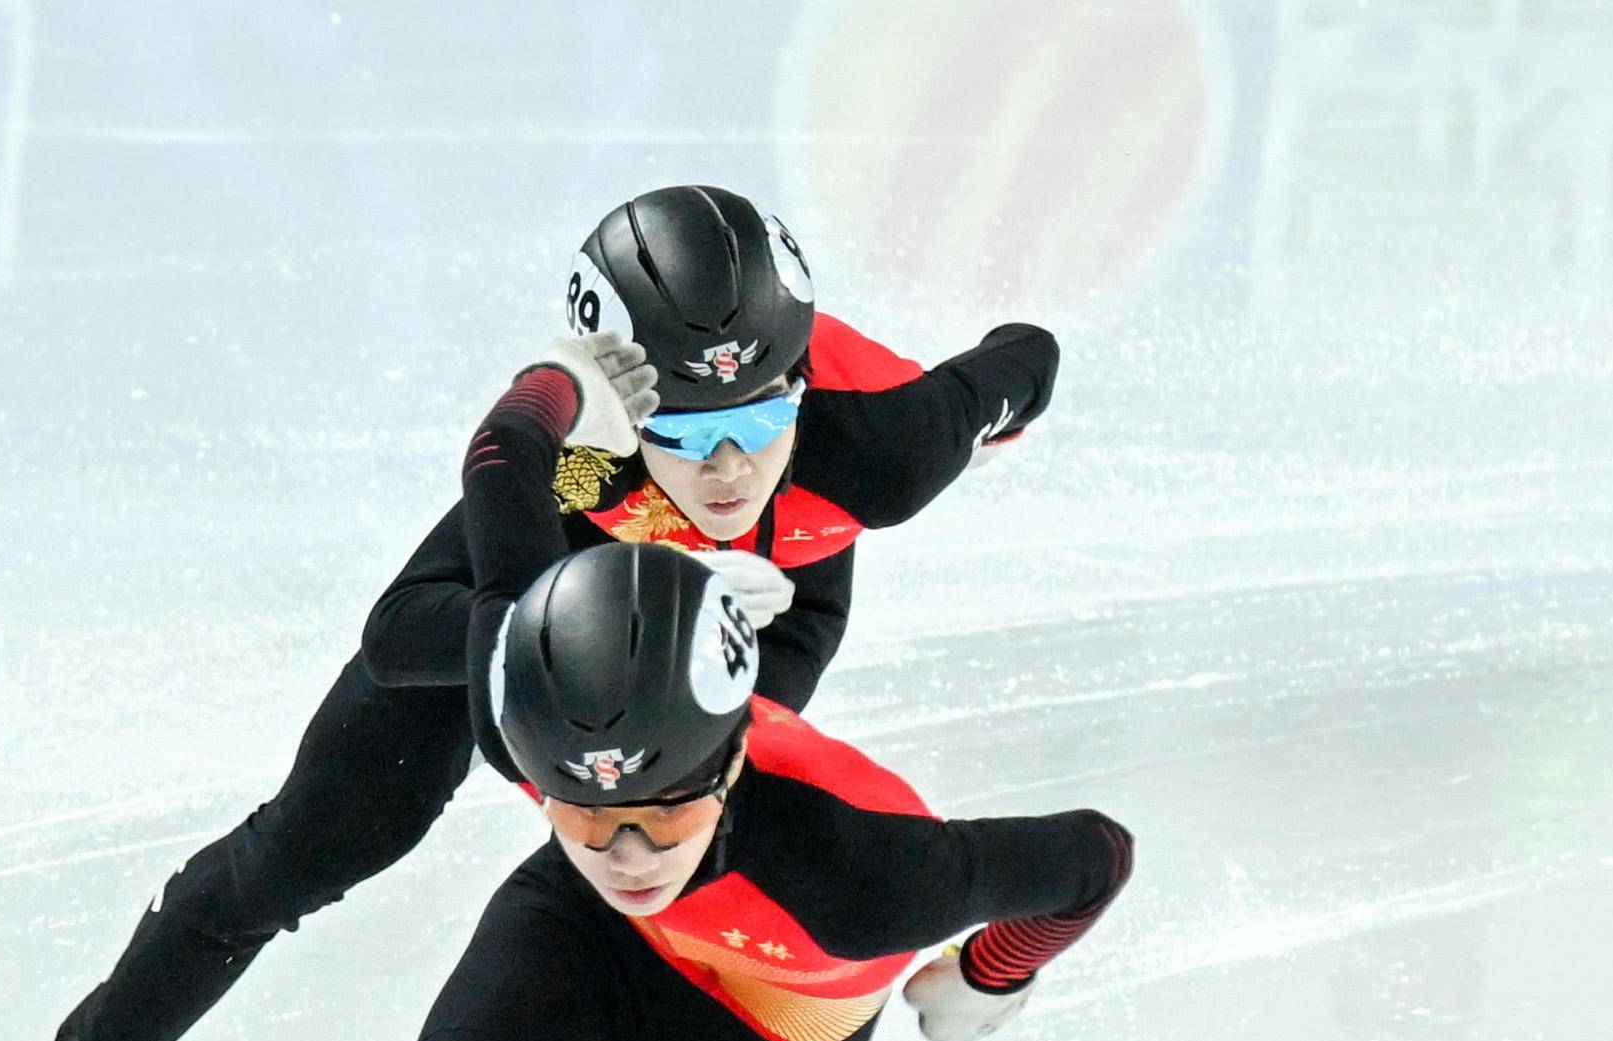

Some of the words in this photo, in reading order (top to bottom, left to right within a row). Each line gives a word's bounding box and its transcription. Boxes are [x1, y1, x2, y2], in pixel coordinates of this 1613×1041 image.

[566, 271, 600, 336] 89
[718, 594, 754, 680] 46
[720, 928, 796, 960] 吉林
